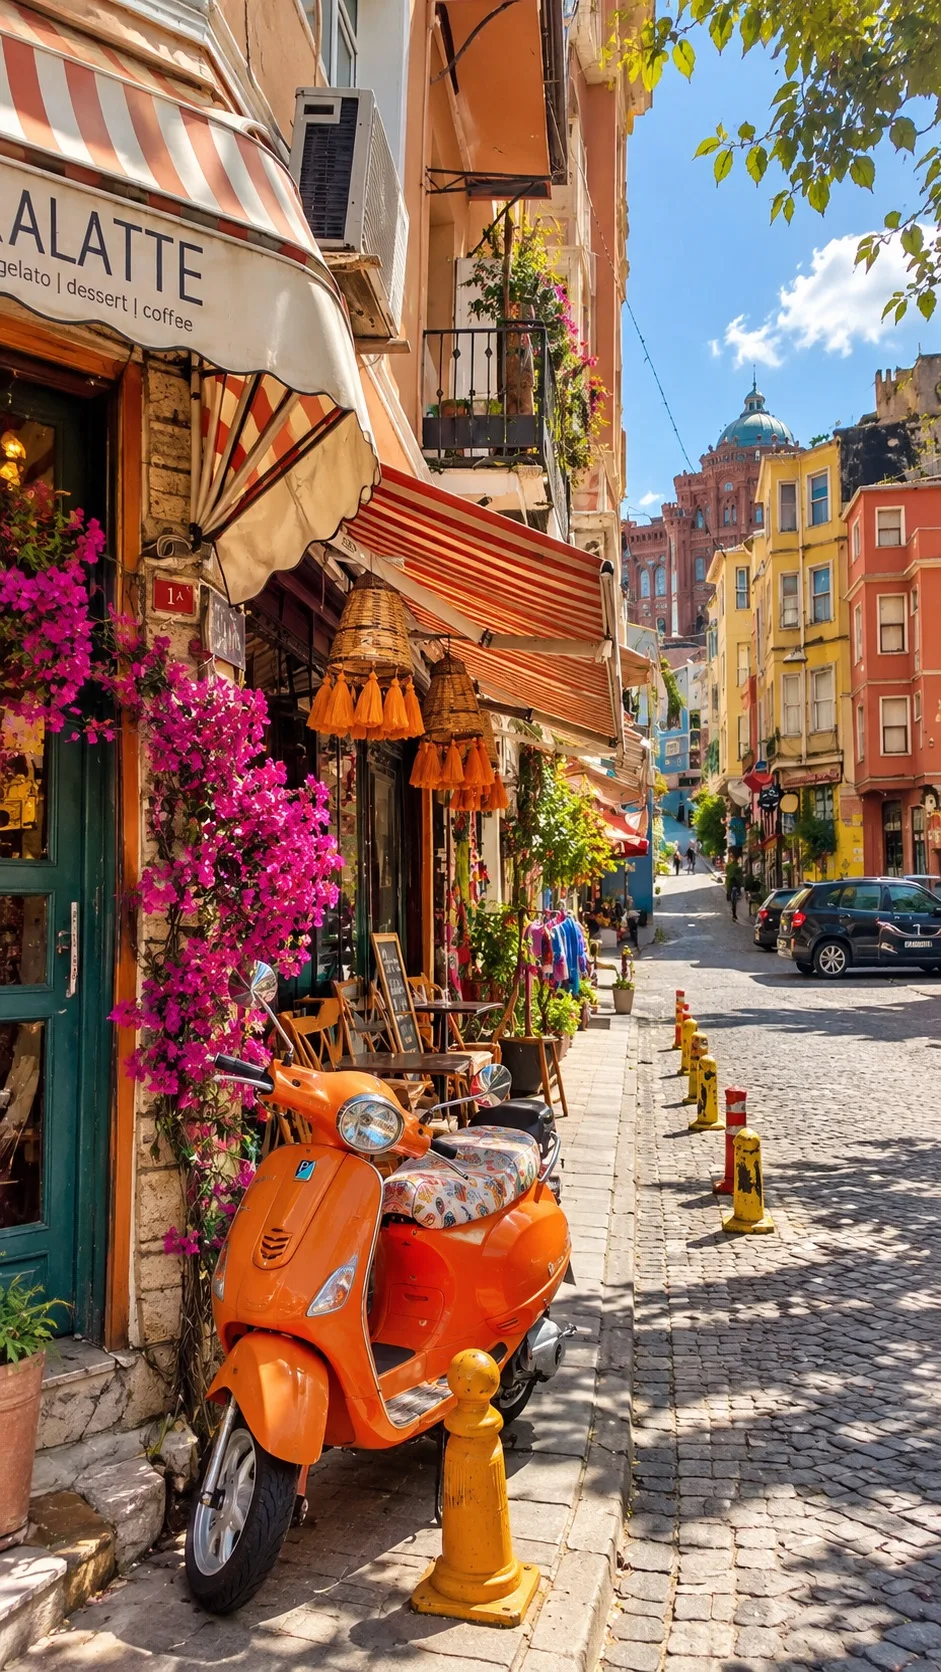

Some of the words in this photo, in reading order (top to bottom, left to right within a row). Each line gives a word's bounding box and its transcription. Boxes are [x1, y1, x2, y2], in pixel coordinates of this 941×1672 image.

[0, 189, 203, 306] ALATTE
[0, 259, 51, 288] gelato
[67, 278, 128, 311] dessert
[143, 305, 193, 332] coffee
